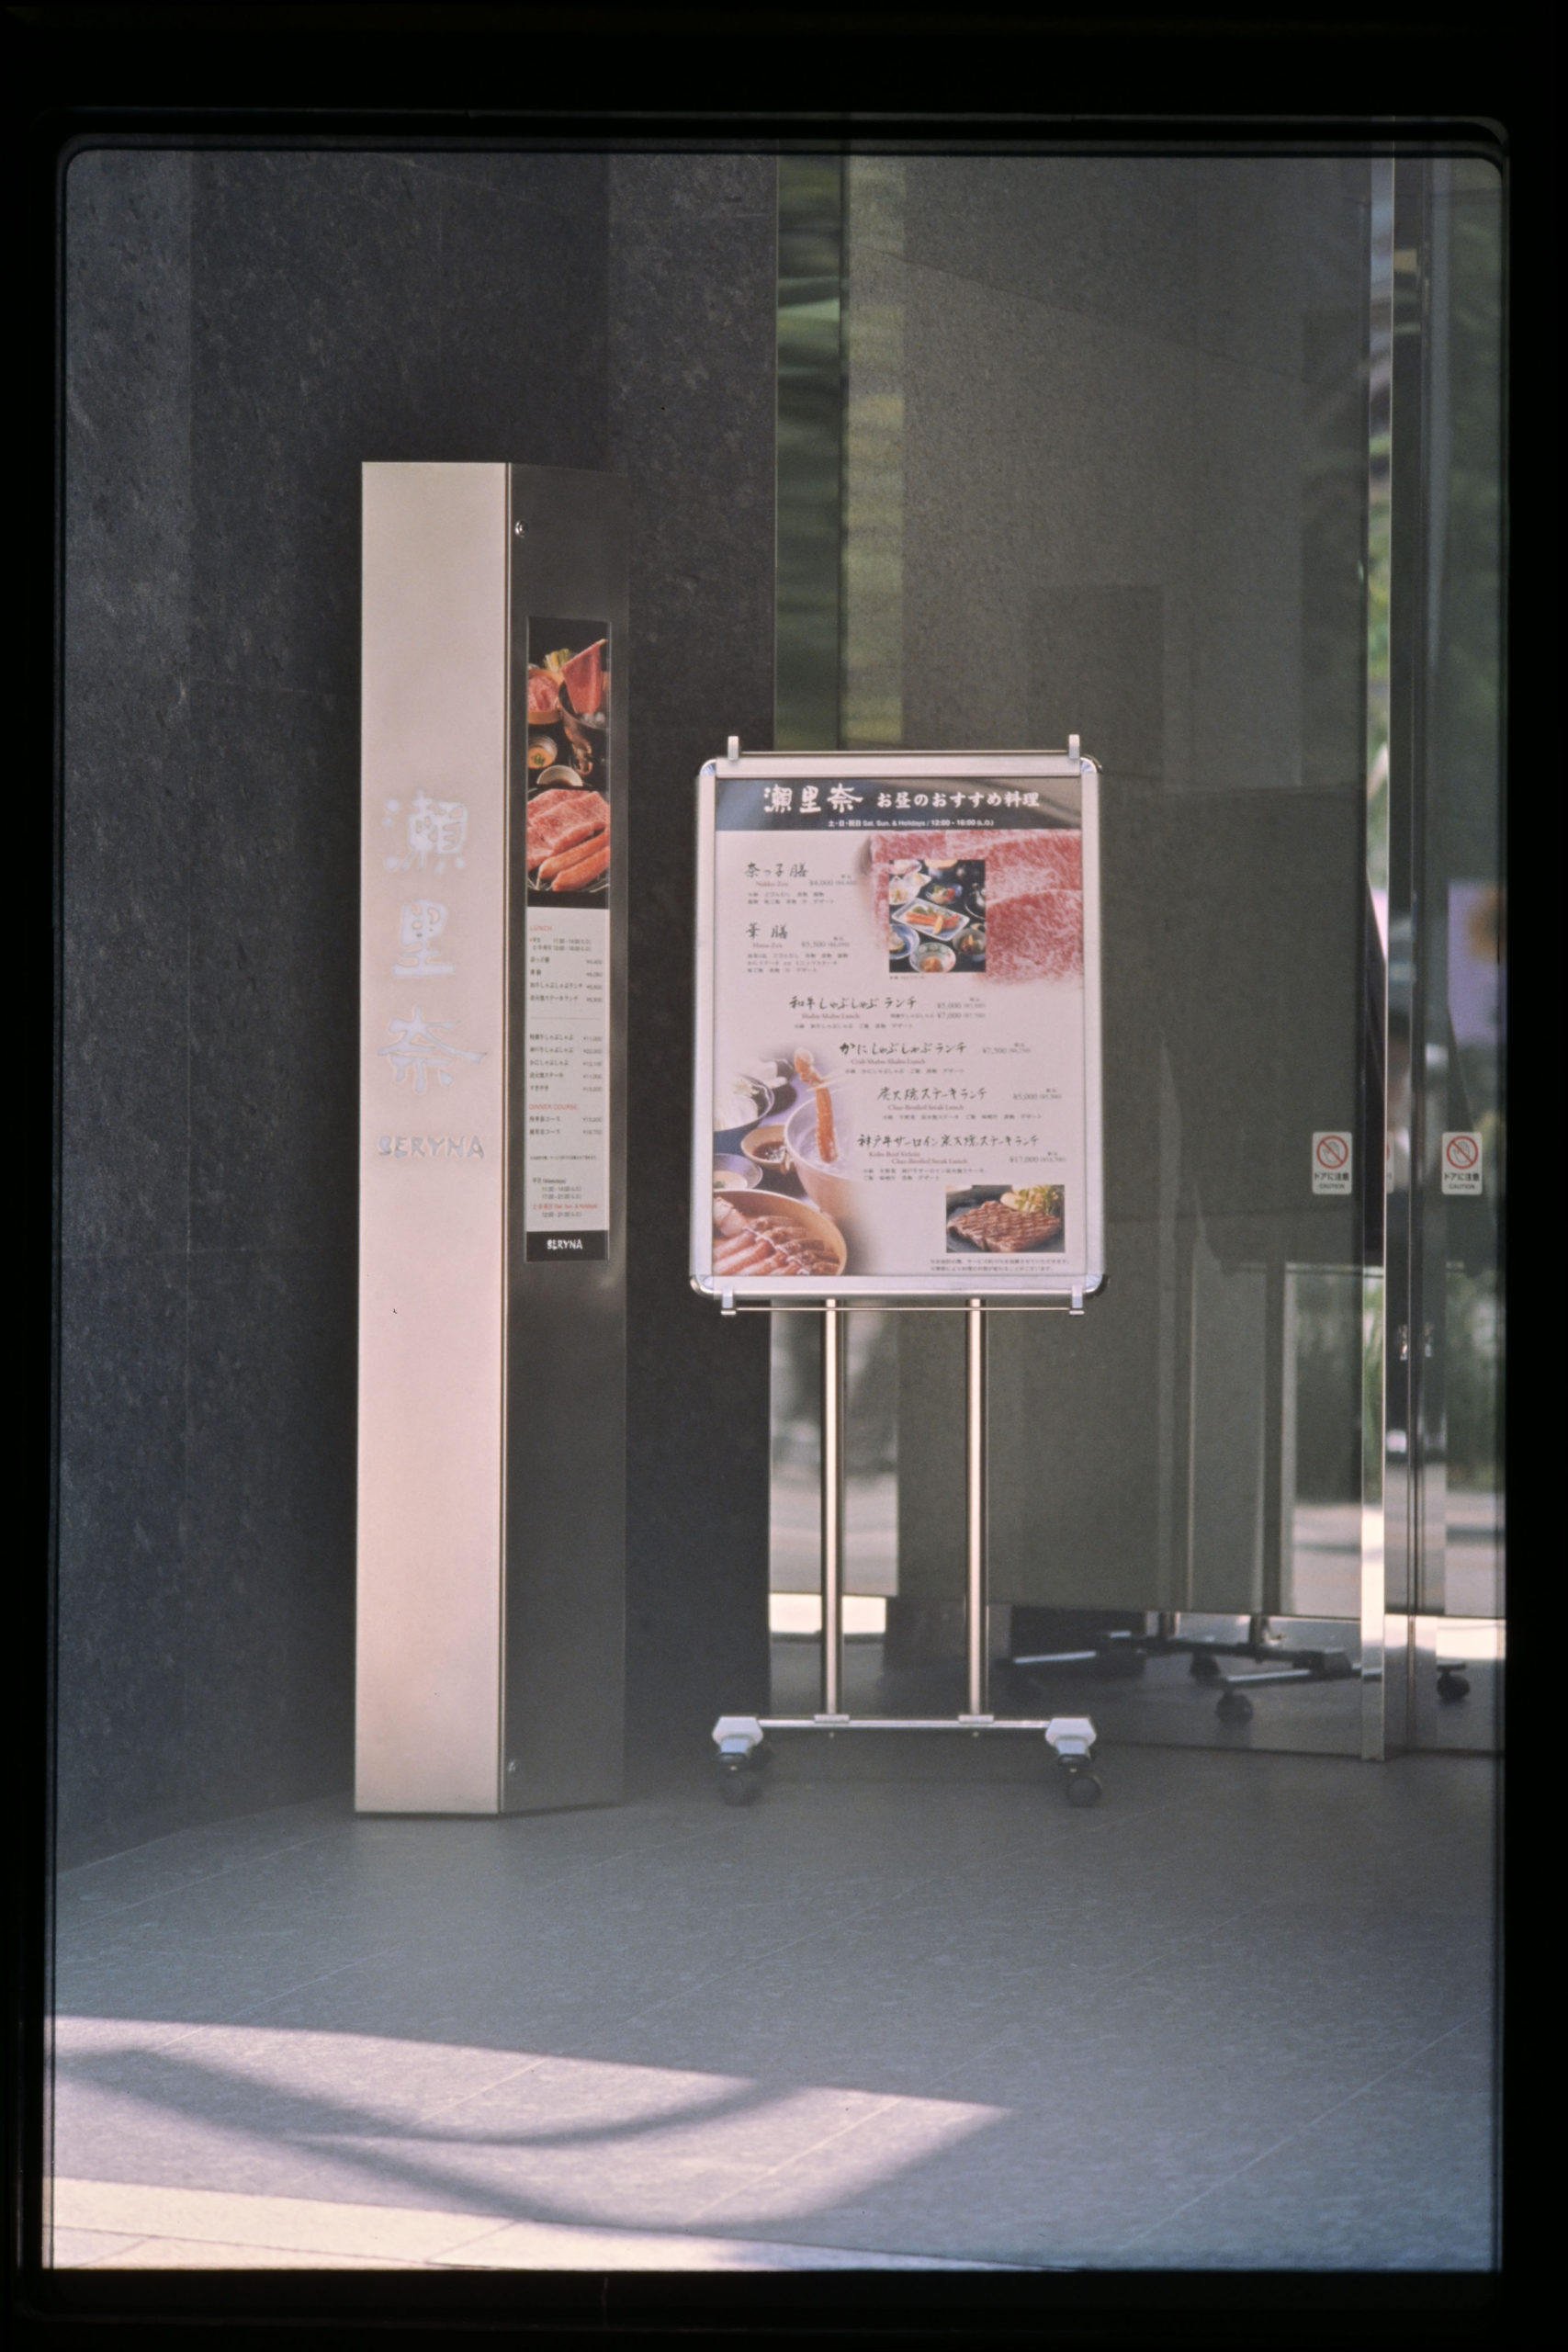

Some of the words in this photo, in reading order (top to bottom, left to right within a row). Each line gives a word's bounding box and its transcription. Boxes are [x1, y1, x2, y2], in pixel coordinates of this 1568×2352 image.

[876, 791, 1041, 808] お昼のおすすめ料理
[898, 820, 925, 828] Holidays
[931, 819, 951, 827] 12:00
[378, 1136, 485, 1159] SERYNA
[1314, 1172, 1349, 1182] ドアに注意
[1444, 1172, 1480, 1182] ドアに注意
[547, 1238, 583, 1250] SERYNA
